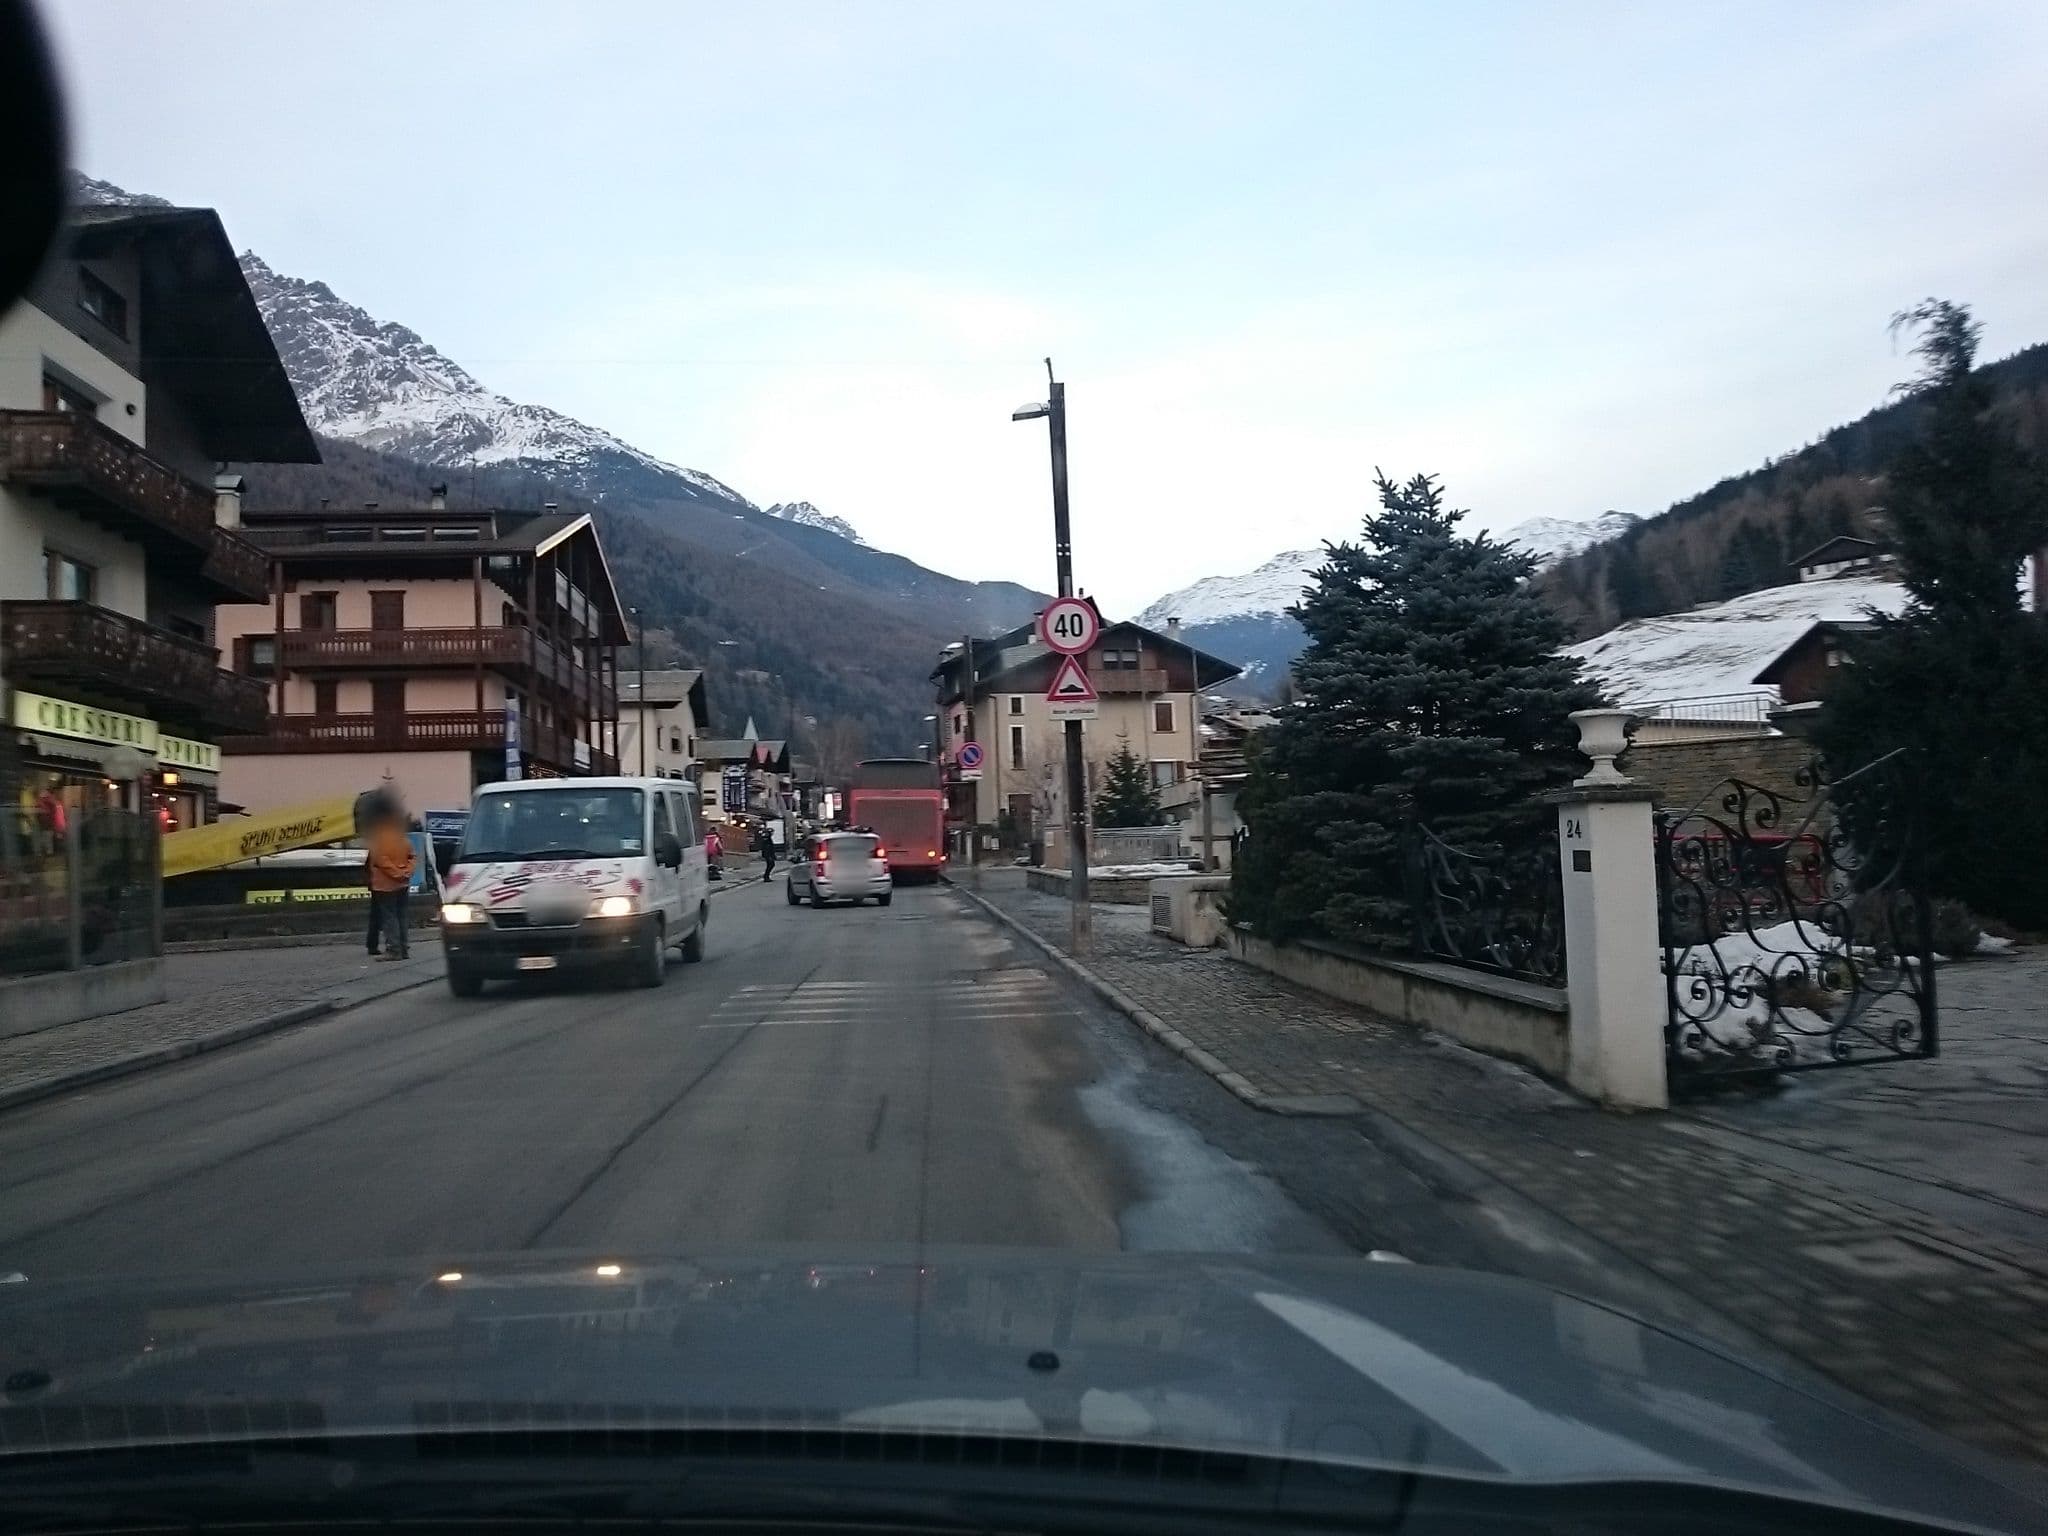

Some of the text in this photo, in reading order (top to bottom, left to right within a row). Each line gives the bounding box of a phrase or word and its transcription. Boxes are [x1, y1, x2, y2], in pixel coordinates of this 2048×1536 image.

[1054, 613, 1083, 637] 40
[164, 740, 212, 767] SPORT
[1566, 819, 1582, 839] 24
